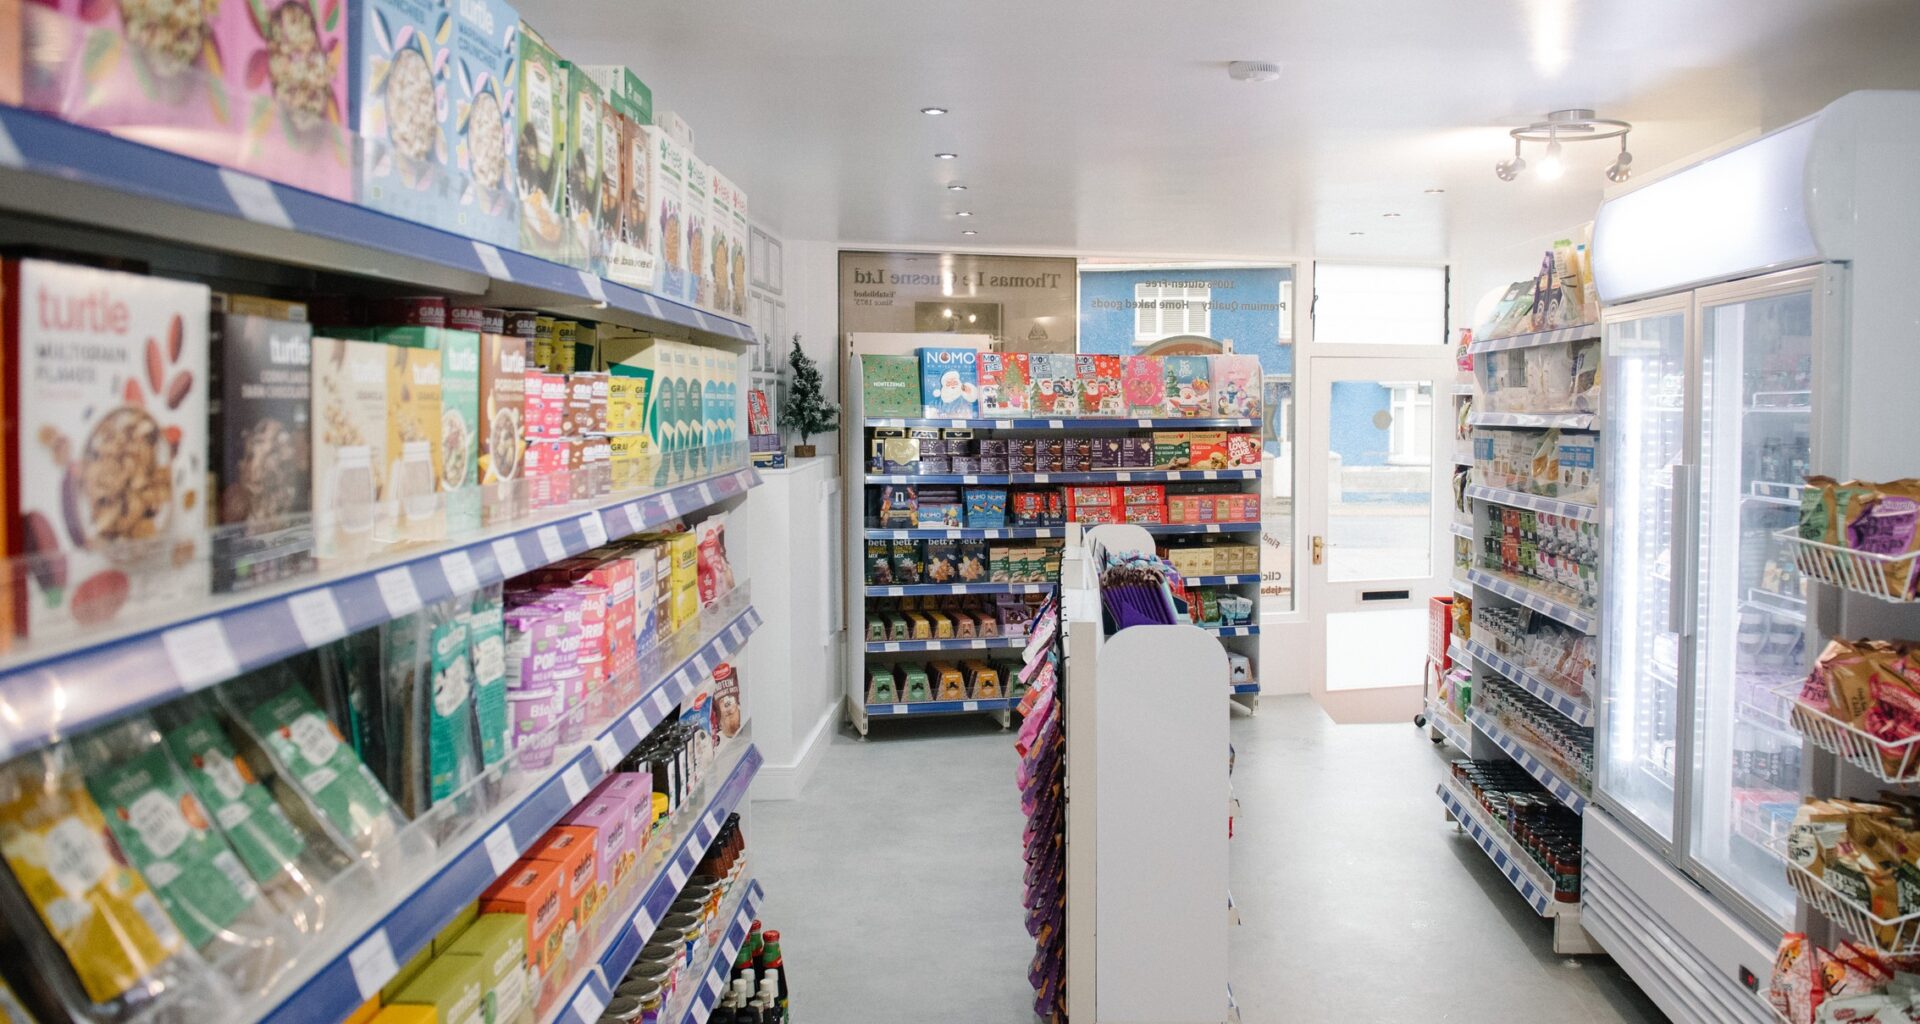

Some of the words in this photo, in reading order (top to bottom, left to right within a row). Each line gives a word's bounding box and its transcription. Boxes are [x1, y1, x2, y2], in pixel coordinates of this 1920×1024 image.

[37, 286, 131, 335] turtle
[269, 332, 311, 366] turtle
[926, 351, 976, 365] NOMO
